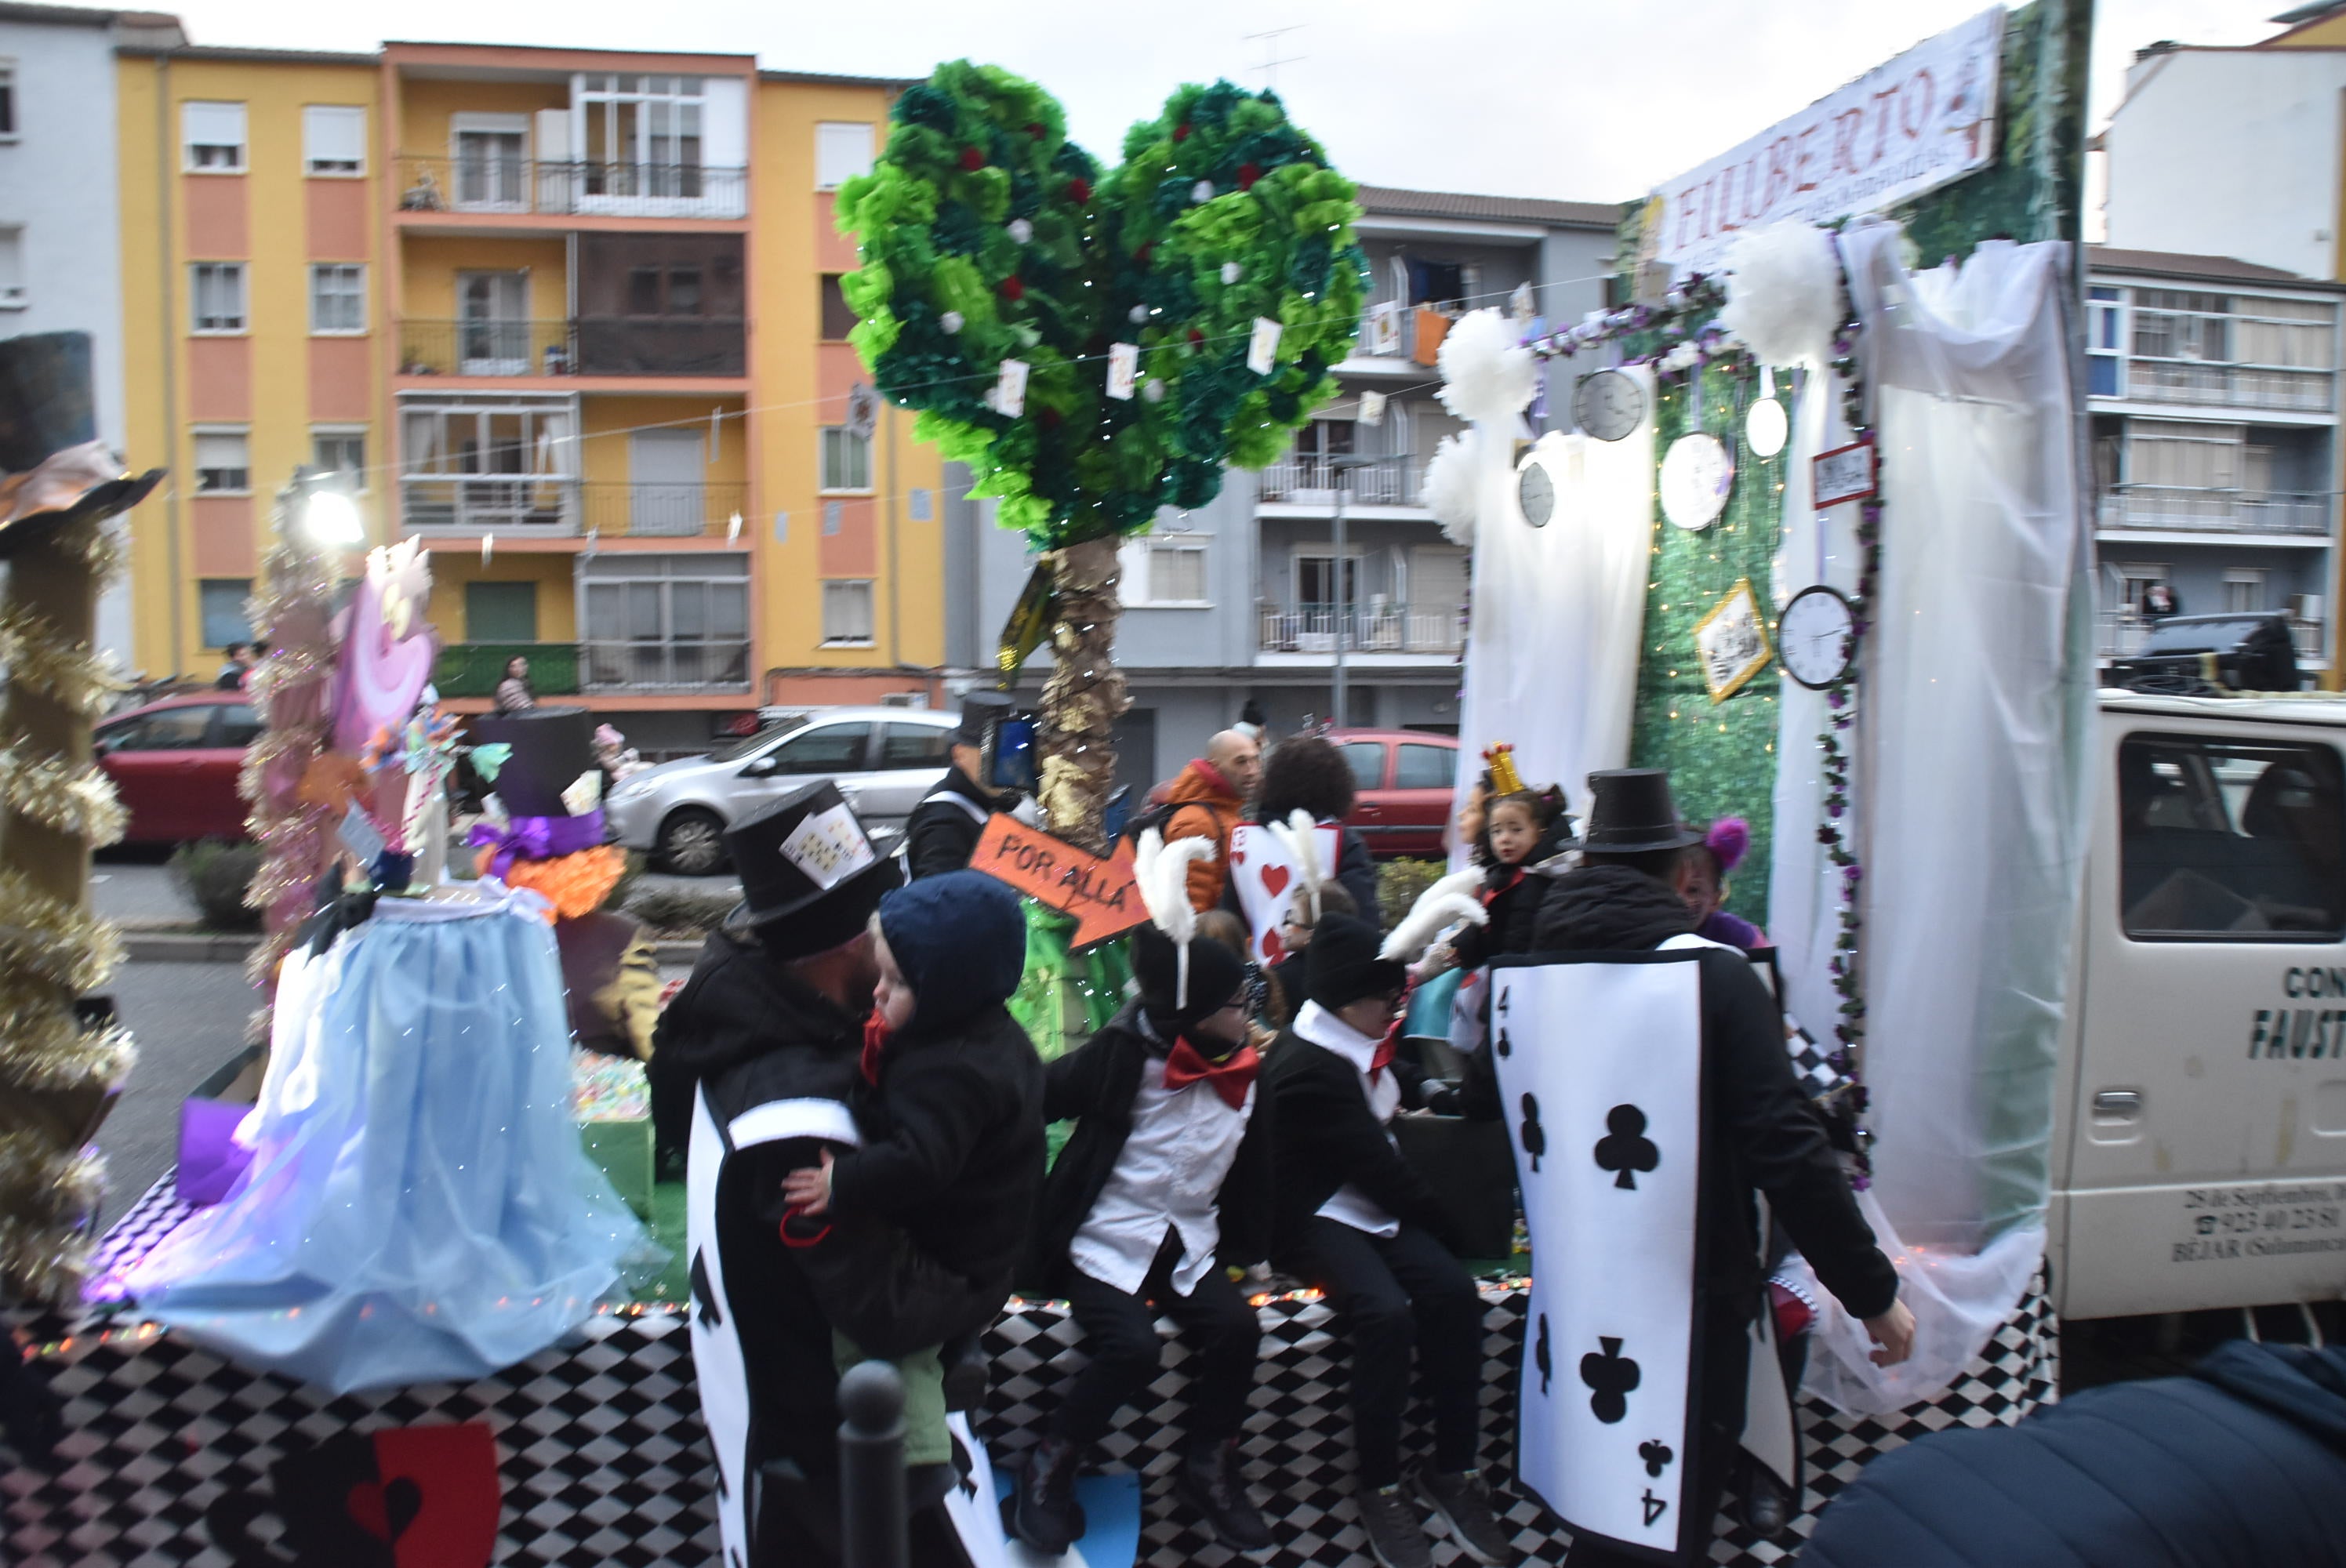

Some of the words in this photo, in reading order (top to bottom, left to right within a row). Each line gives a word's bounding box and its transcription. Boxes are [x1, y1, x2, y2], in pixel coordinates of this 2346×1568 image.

[997, 833, 1055, 881] POR
[1498, 984, 1510, 1019] 4
[1641, 1488, 1668, 1527] 4
